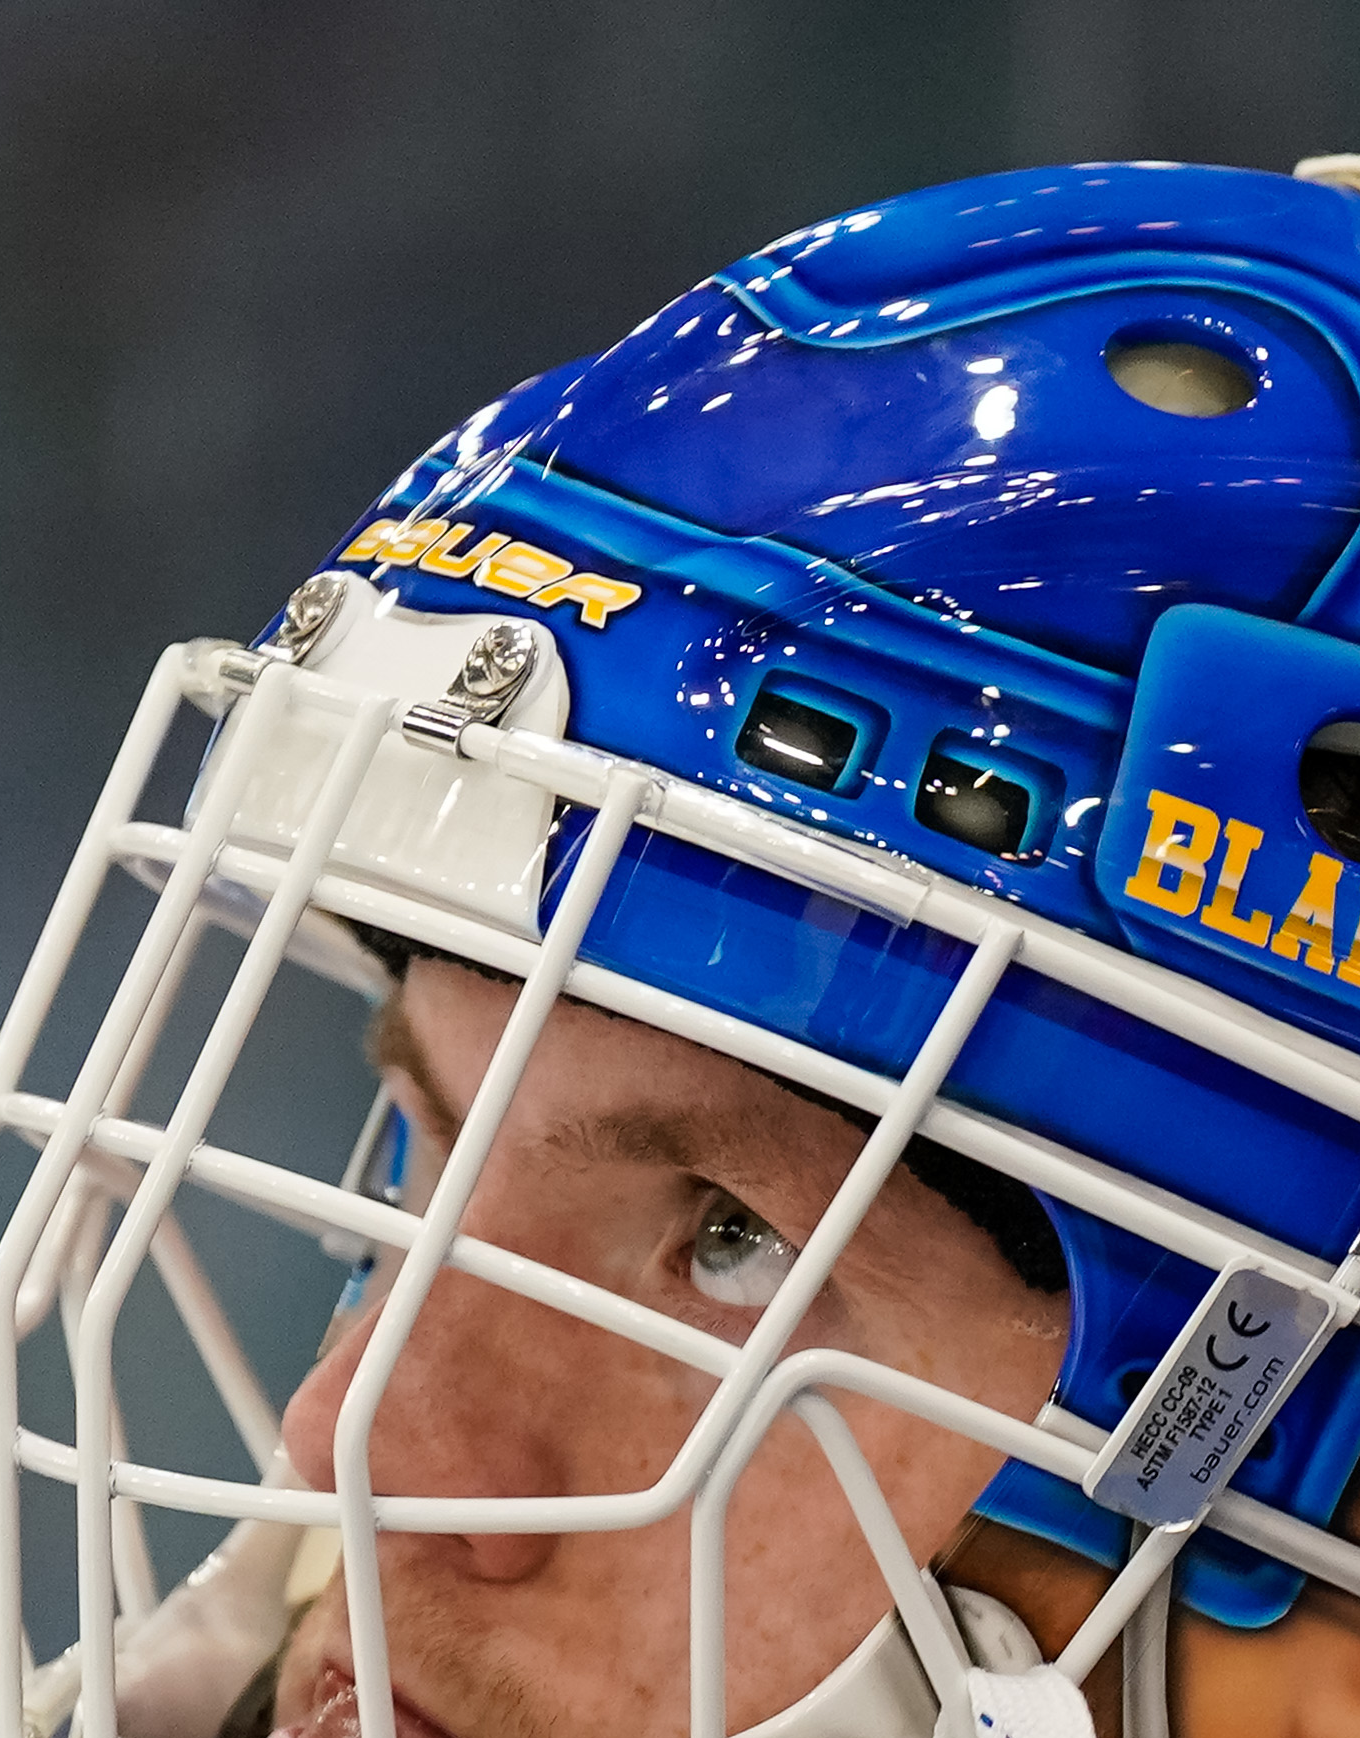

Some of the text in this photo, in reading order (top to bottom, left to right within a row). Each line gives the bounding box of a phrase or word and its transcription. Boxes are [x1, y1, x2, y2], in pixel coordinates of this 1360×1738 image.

[1129, 1411, 1169, 1460] HECC
[1136, 1375, 1217, 1492] ASTM F1587-12
[1187, 1397, 1227, 1442] TYPE
[1190, 1357, 1286, 1484] bauer.com
